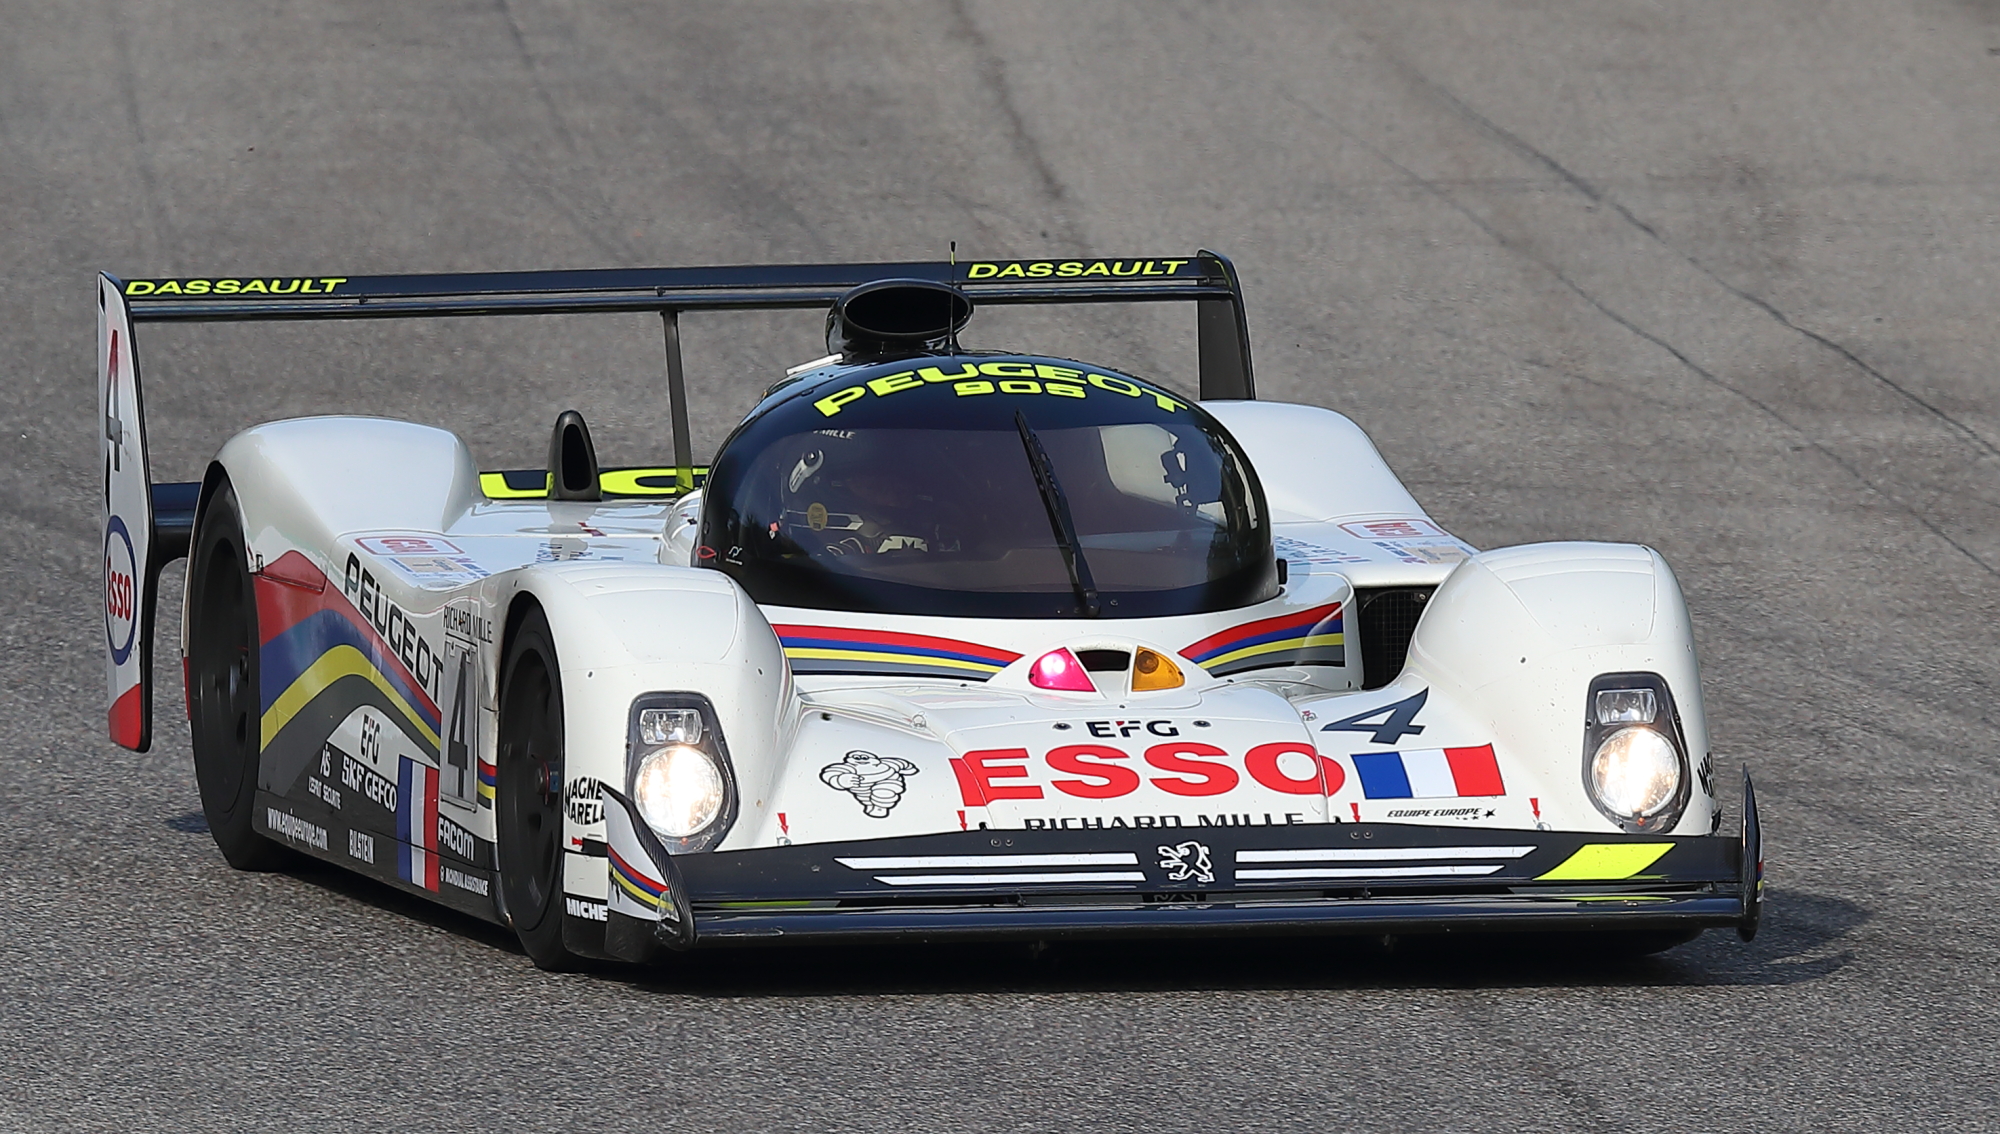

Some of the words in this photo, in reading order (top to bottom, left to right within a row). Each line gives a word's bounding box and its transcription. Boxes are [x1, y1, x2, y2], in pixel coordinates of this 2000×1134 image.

[126, 278, 347, 295] DASSAULT
[967, 261, 1188, 279] DASSAULT
[812, 361, 1188, 417] PEUGEOT
[952, 380, 1087, 399] 905
[344, 552, 443, 704] PEUGEOT
[448, 651, 468, 799] 4
[1085, 720, 1179, 738] EFG
[1320, 686, 1429, 745] 4
[360, 713, 381, 766] EFG
[342, 754, 364, 793] SKF
[365, 771, 397, 813] GEFCO
[948, 741, 1345, 807] ESSO
[1024, 815, 1183, 830] RICHARD
[1198, 813, 1304, 828] MILLE
[1387, 809, 1433, 818] EQUIPE
[1433, 808, 1482, 817] EUROPE
[349, 828, 374, 865] BILSTEIN
[437, 816, 474, 862] FACOM
[565, 898, 608, 922] MICHE
